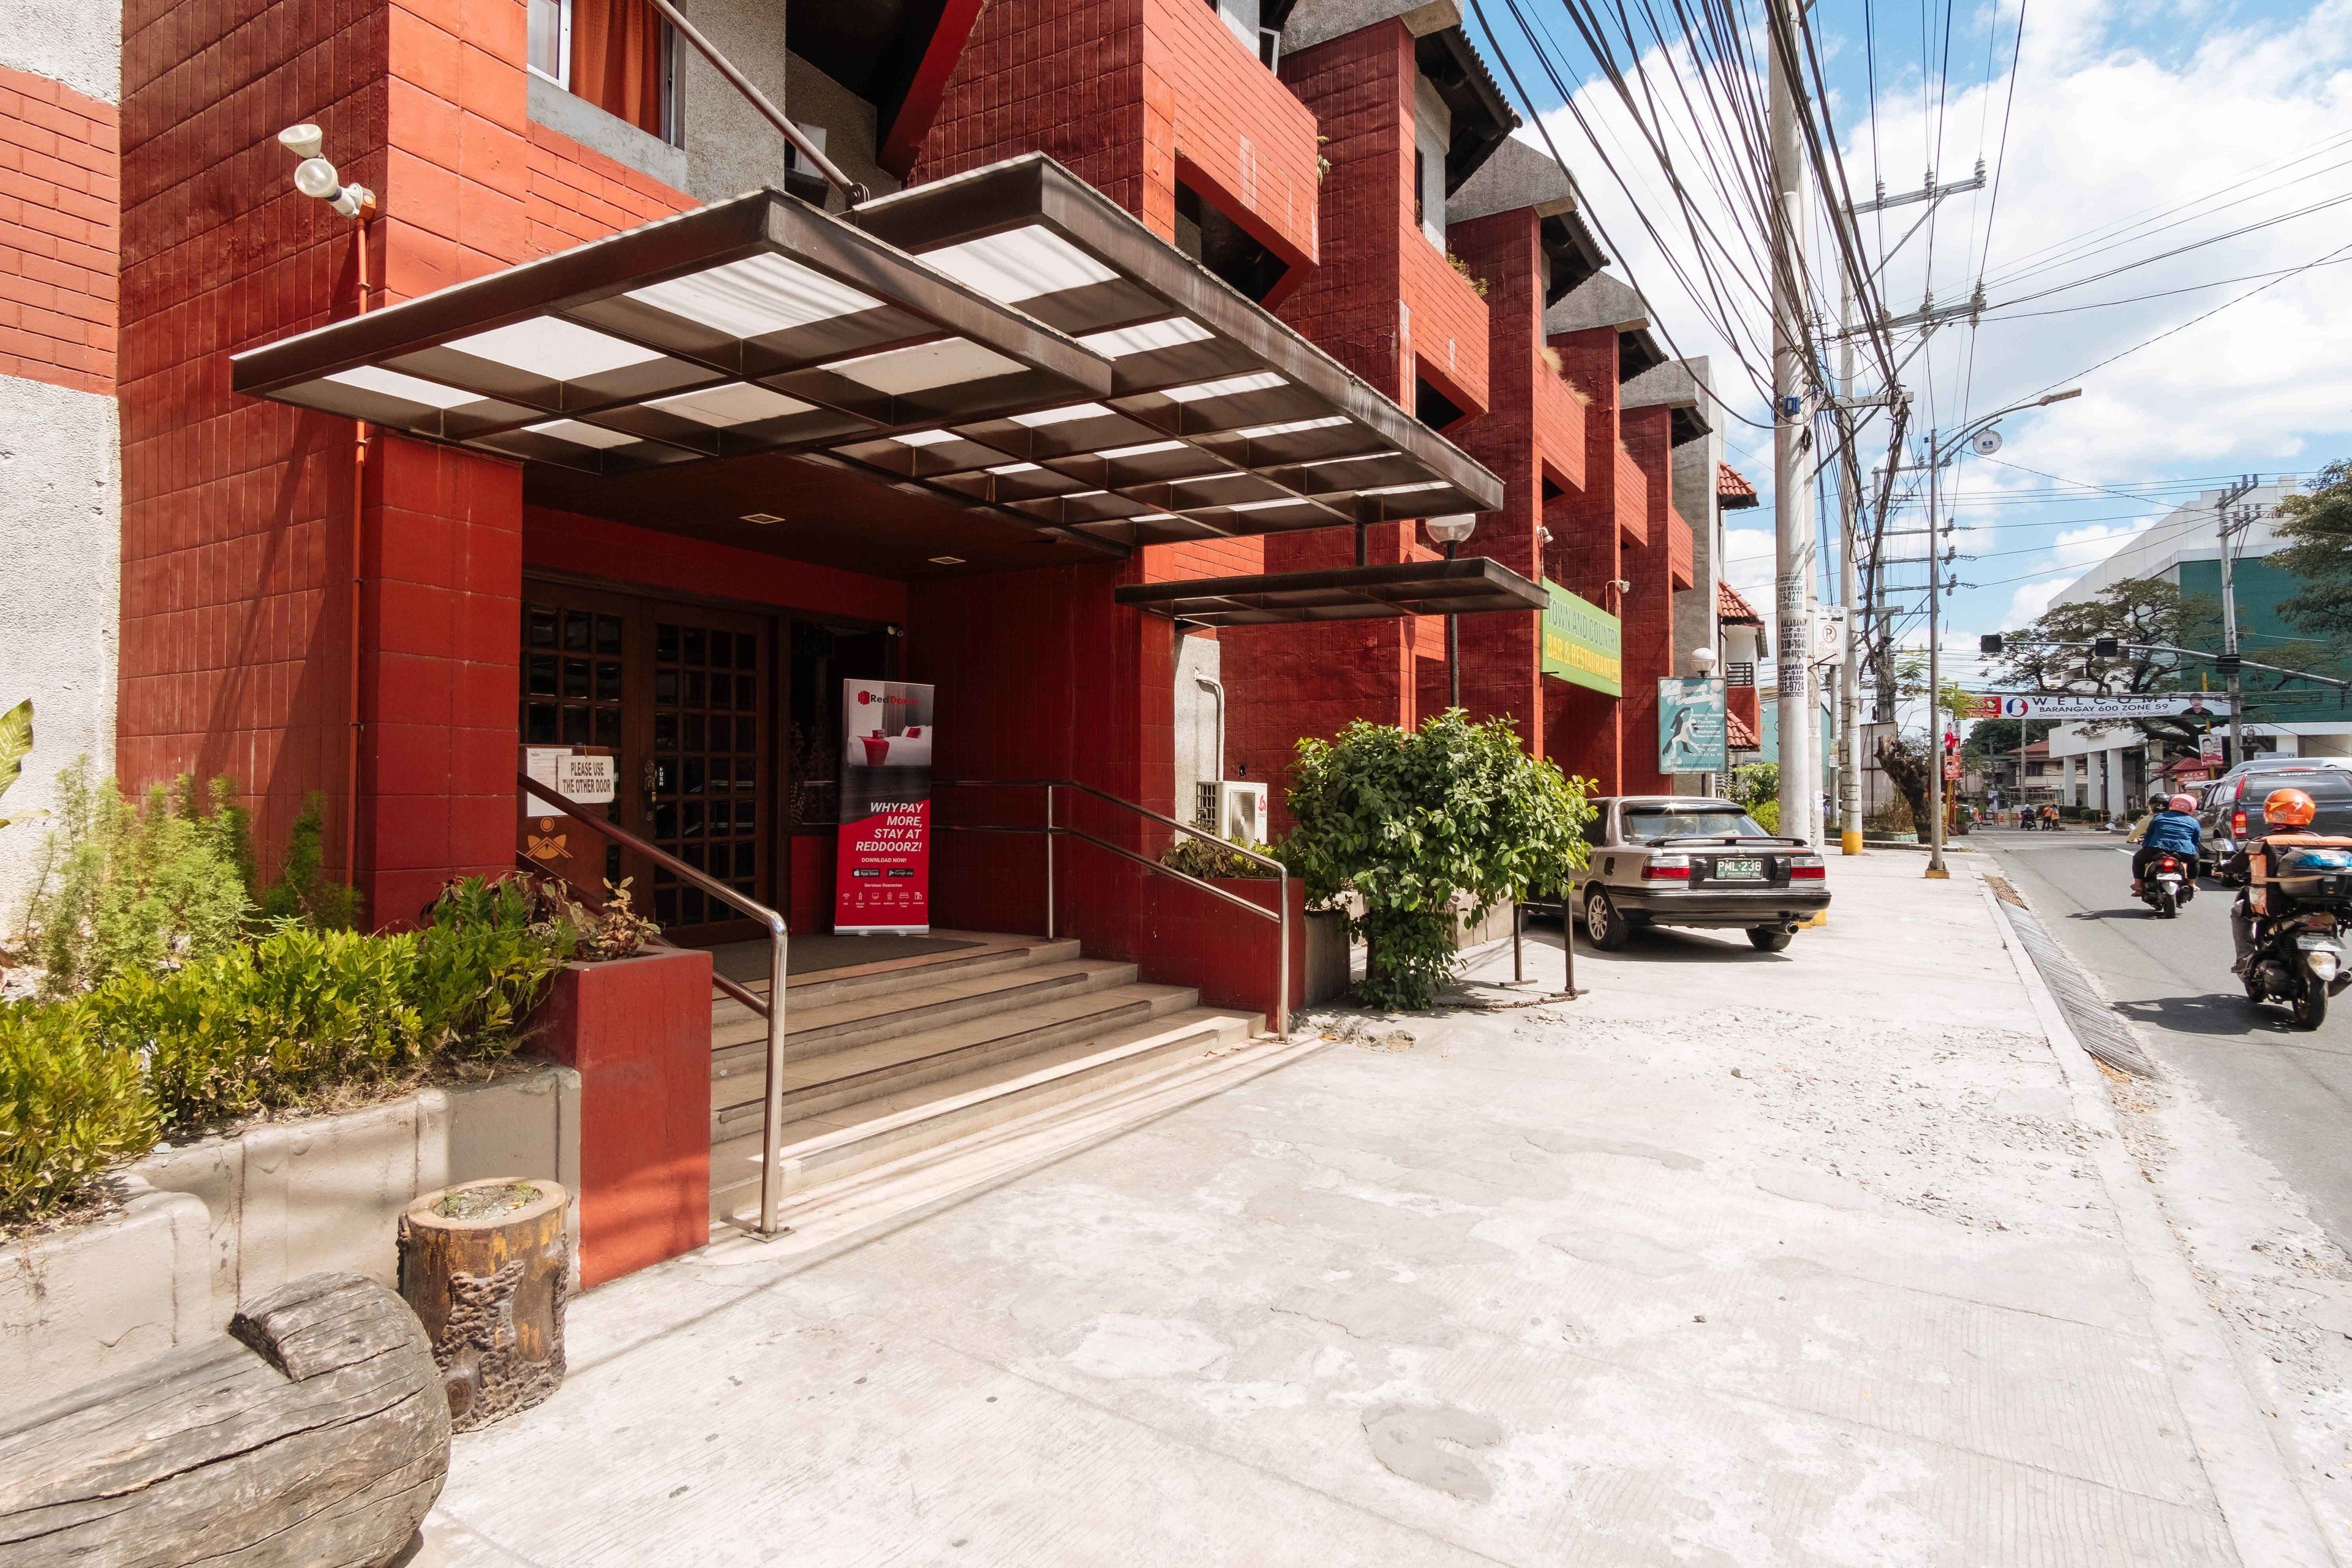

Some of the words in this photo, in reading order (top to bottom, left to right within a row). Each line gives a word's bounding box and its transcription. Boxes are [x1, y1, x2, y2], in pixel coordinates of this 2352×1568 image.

[1549, 597, 1571, 634] TOWN
[1572, 609, 1588, 640] AND
[1589, 617, 1619, 654] COUNTRY
[1547, 633, 1562, 663] BAR
[1564, 641, 1570, 666] &
[1572, 643, 1610, 679] RESTAURANT
[2032, 693, 2176, 706] WELCOME
[571, 762, 592, 776] PLEASE
[594, 762, 604, 776] USE
[563, 779, 574, 793] THE
[576, 779, 595, 793] OTHER
[596, 779, 611, 793] DOOR
[870, 802, 900, 812] WHY
[900, 804, 923, 813] PAY
[887, 816, 922, 827] MORE,
[874, 829, 904, 839] STAY
[905, 829, 922, 839] AT
[856, 842, 922, 851] REDDOORZ!
[1718, 861, 1738, 871] PML
[1741, 861, 1762, 871] 238
